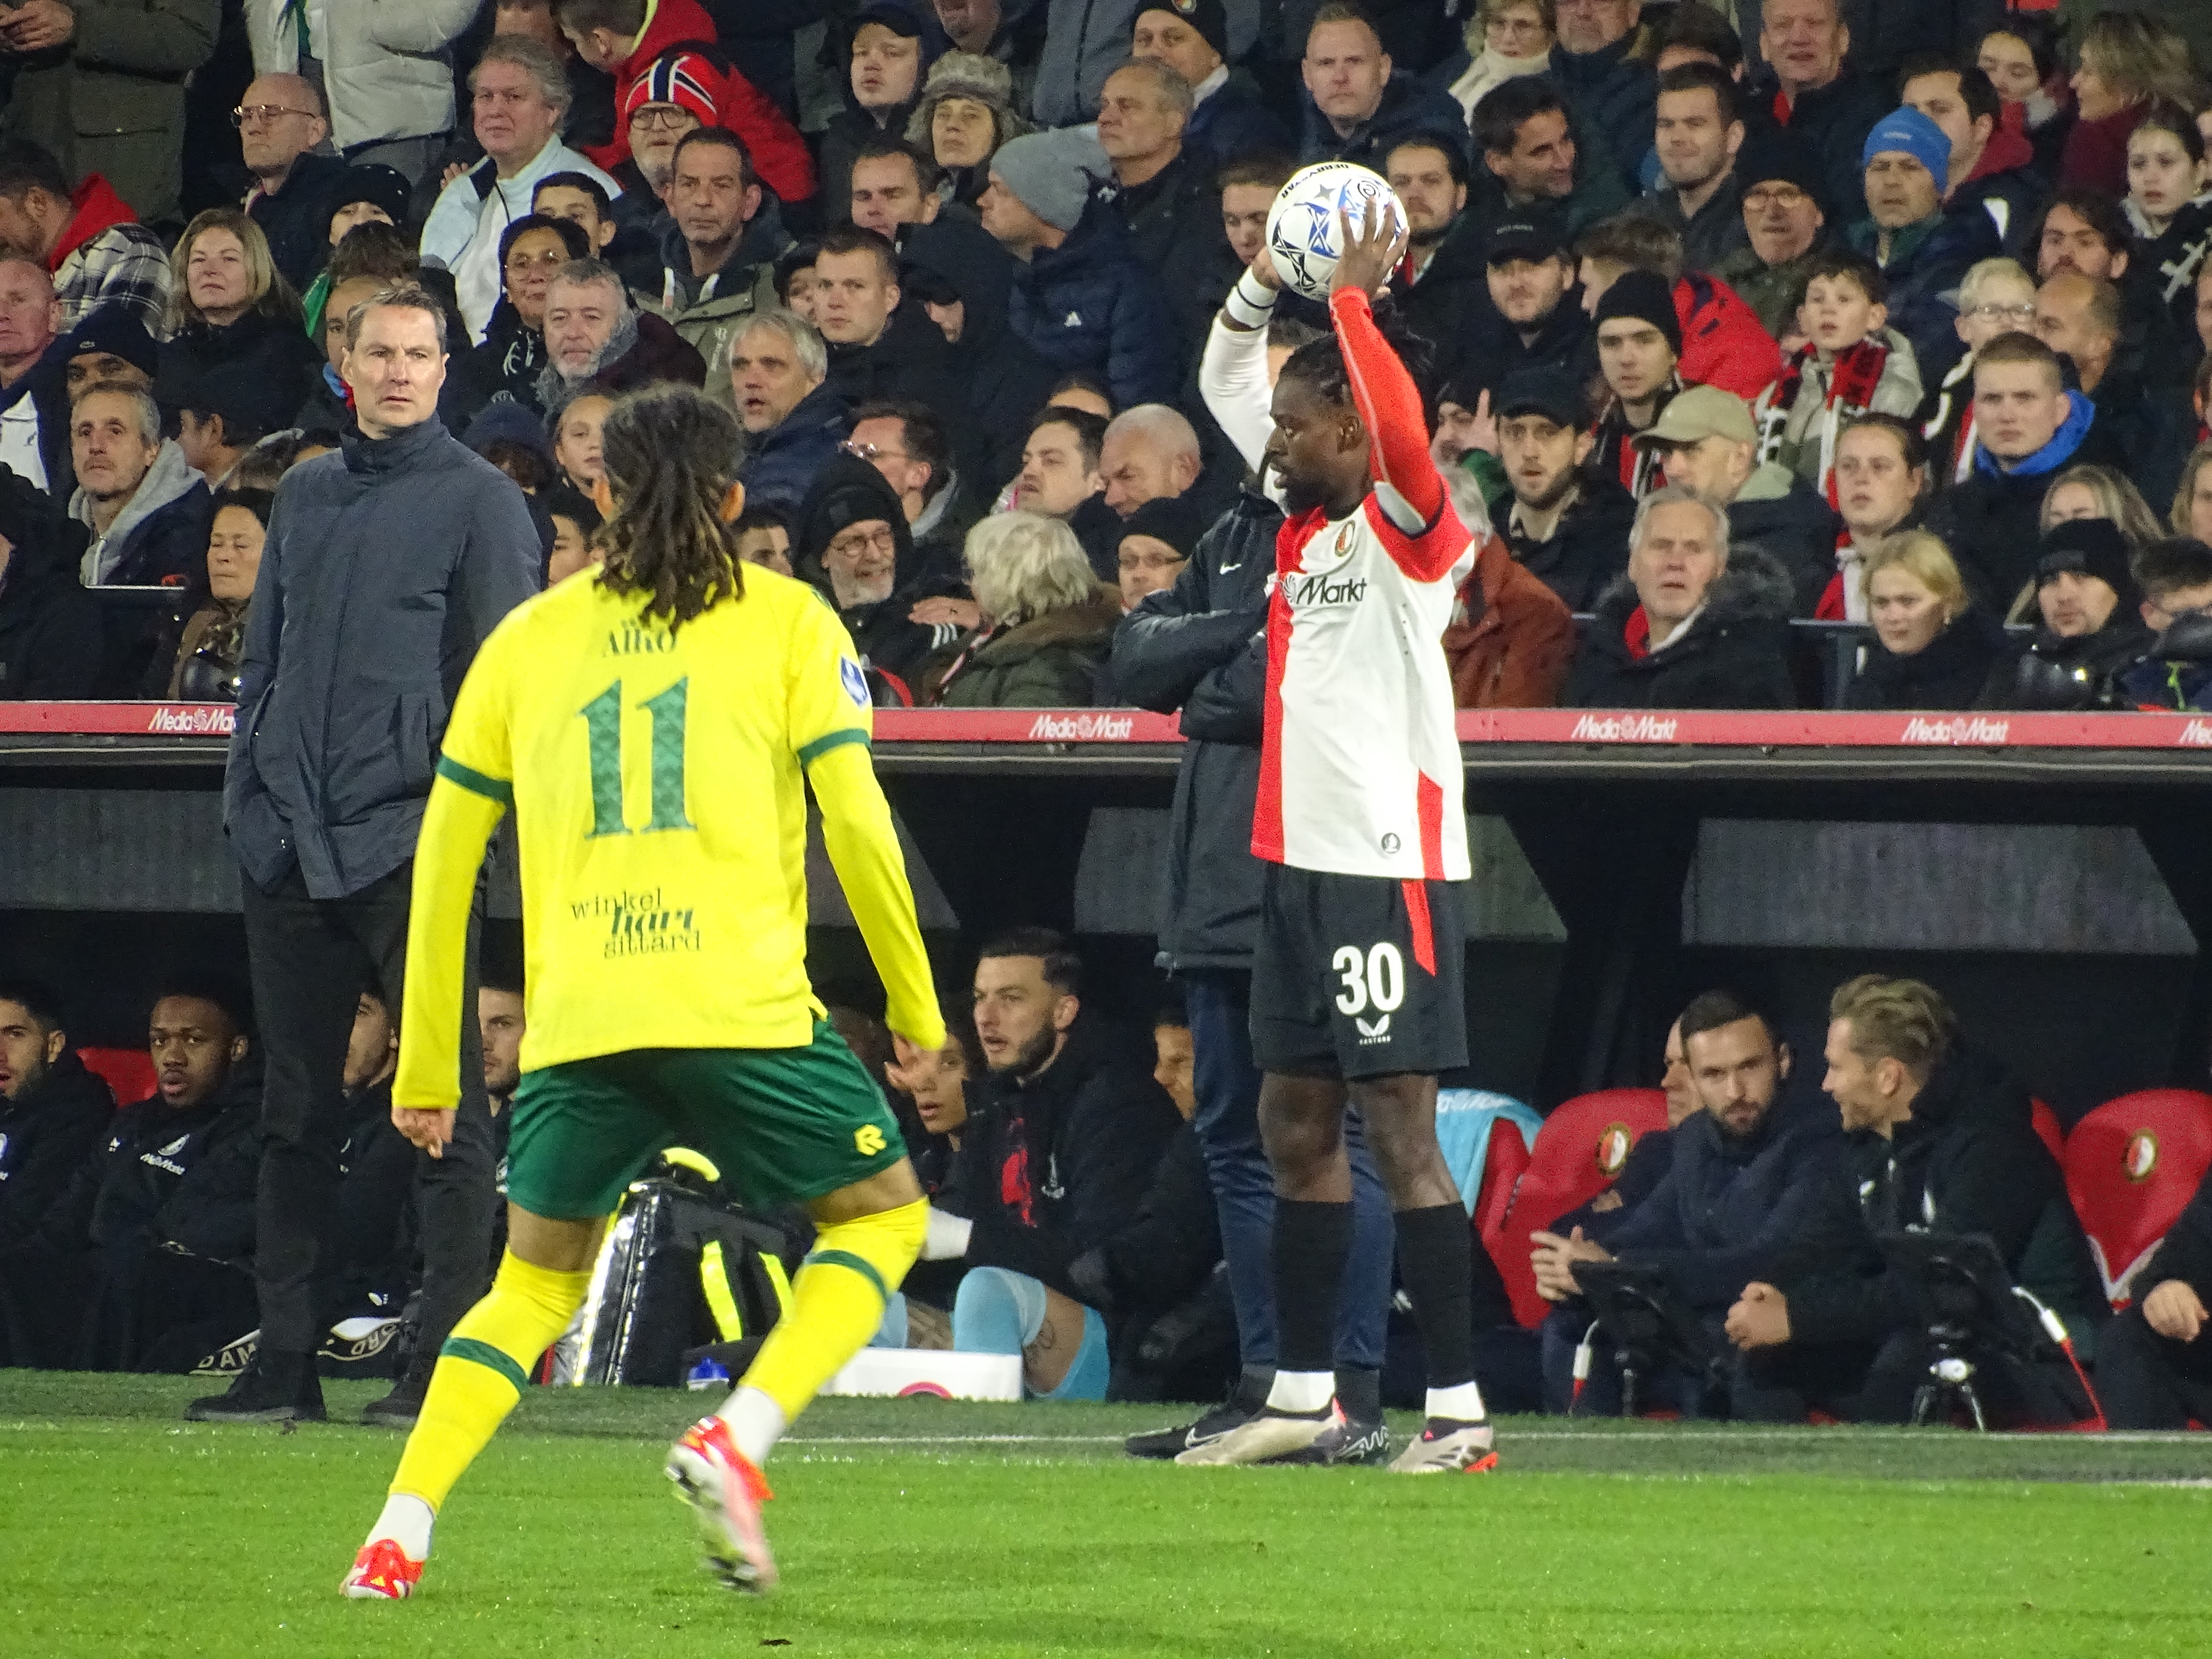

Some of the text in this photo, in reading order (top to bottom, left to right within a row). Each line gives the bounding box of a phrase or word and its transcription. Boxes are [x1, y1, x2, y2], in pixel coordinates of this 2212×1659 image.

[1296, 576, 1368, 605] Markt
[576, 675, 698, 840] 11
[1332, 942, 1405, 1015] 30
